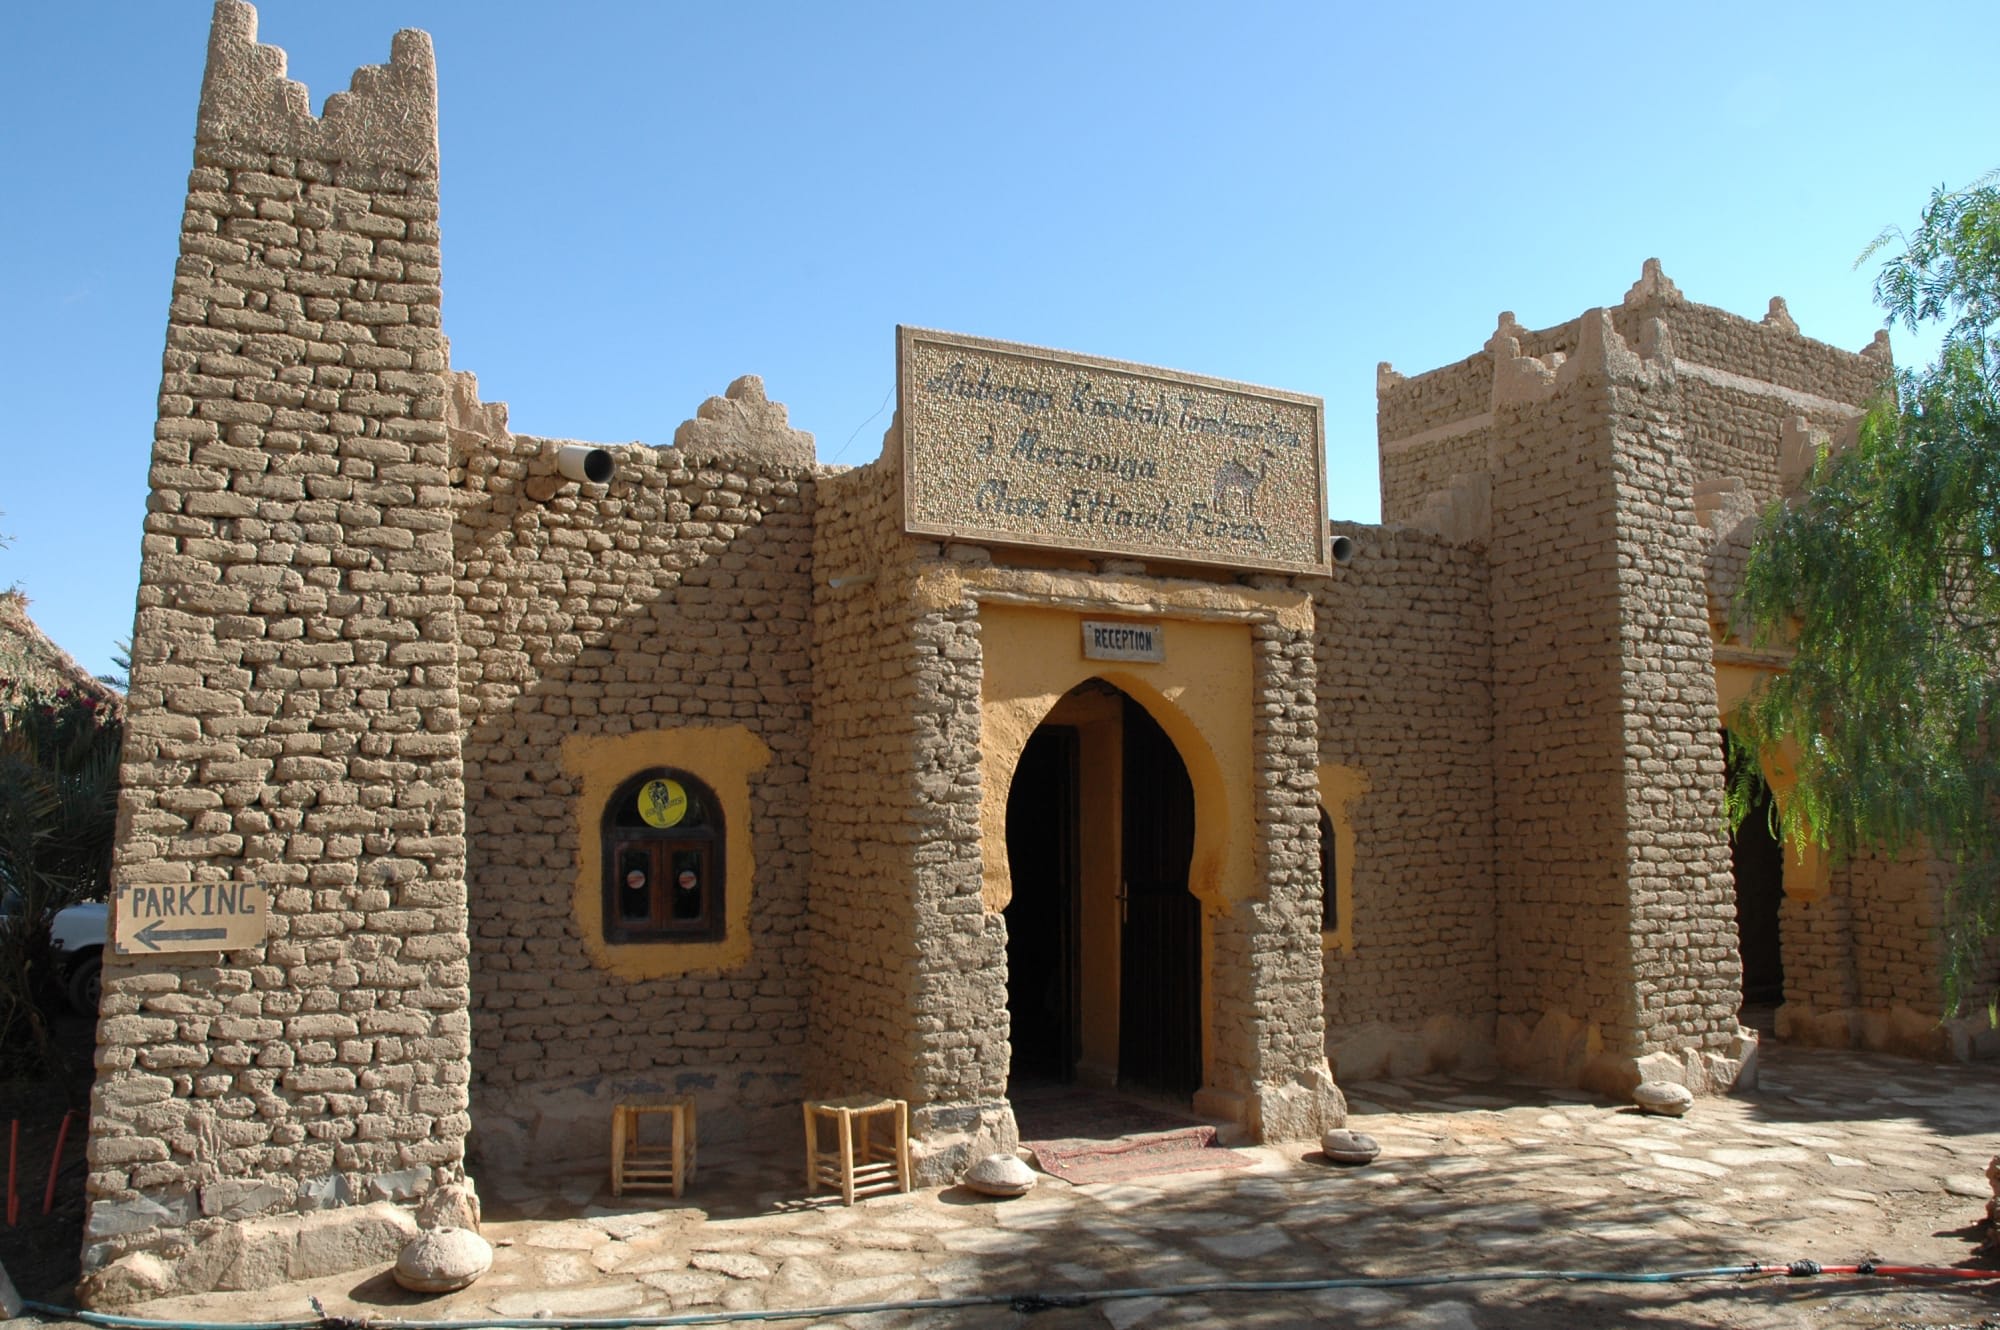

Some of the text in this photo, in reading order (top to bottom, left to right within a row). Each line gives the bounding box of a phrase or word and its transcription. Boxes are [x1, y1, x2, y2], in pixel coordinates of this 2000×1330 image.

[1068, 381, 1170, 428] Kasbah
[1010, 428, 1157, 481] Merzouga
[1094, 628, 1152, 651] RECEPTION
[132, 884, 255, 918] PARKING
